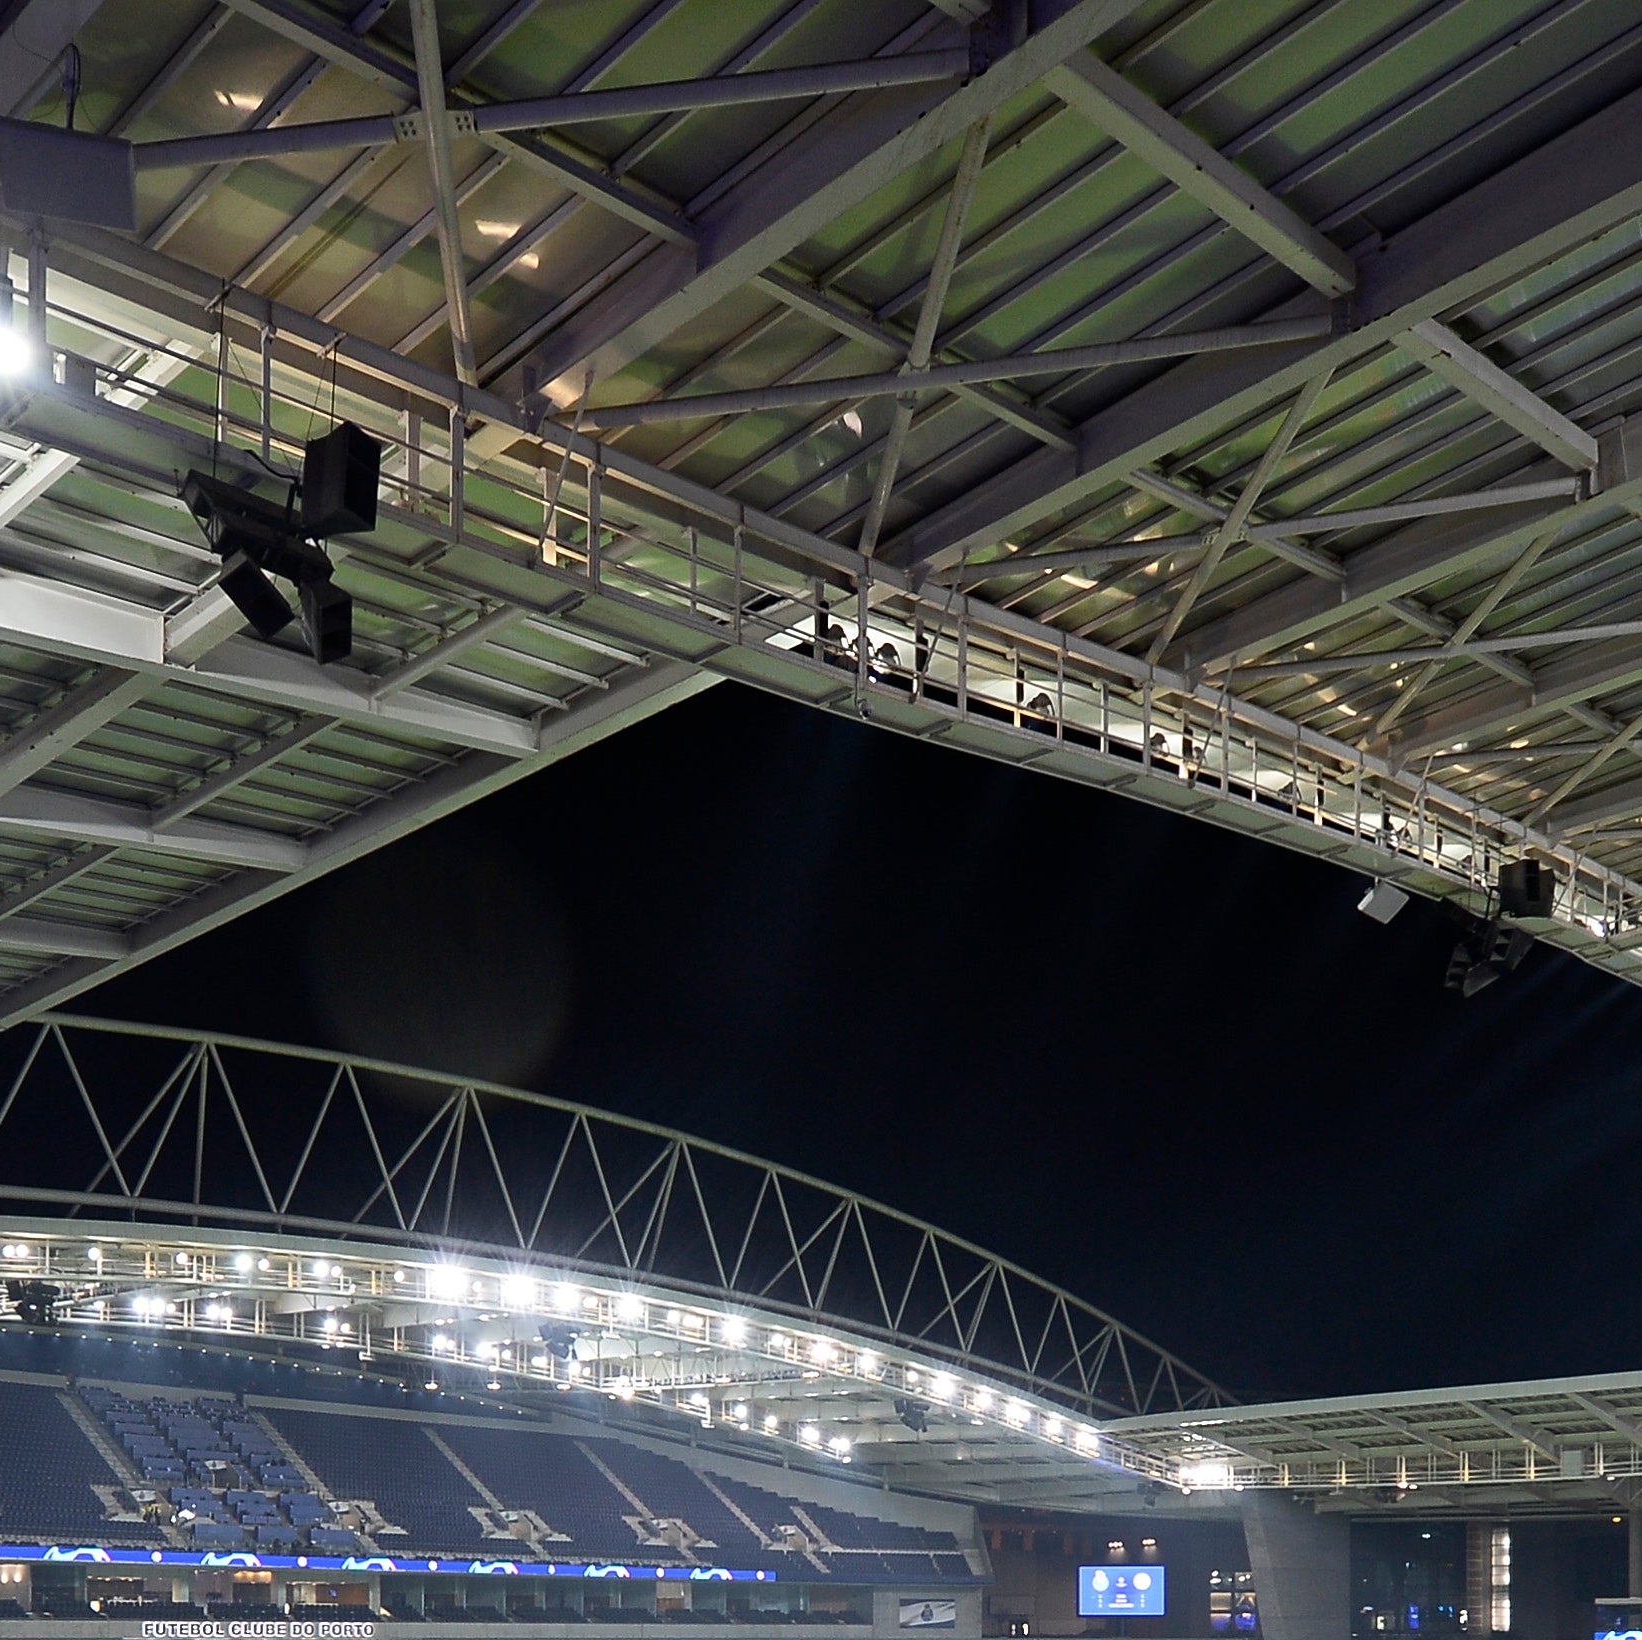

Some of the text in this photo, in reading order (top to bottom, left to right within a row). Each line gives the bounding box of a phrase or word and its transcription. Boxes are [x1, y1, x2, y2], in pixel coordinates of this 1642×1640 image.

[143, 1622, 374, 1637] FUTEBOL CLUBE DO PORTO
